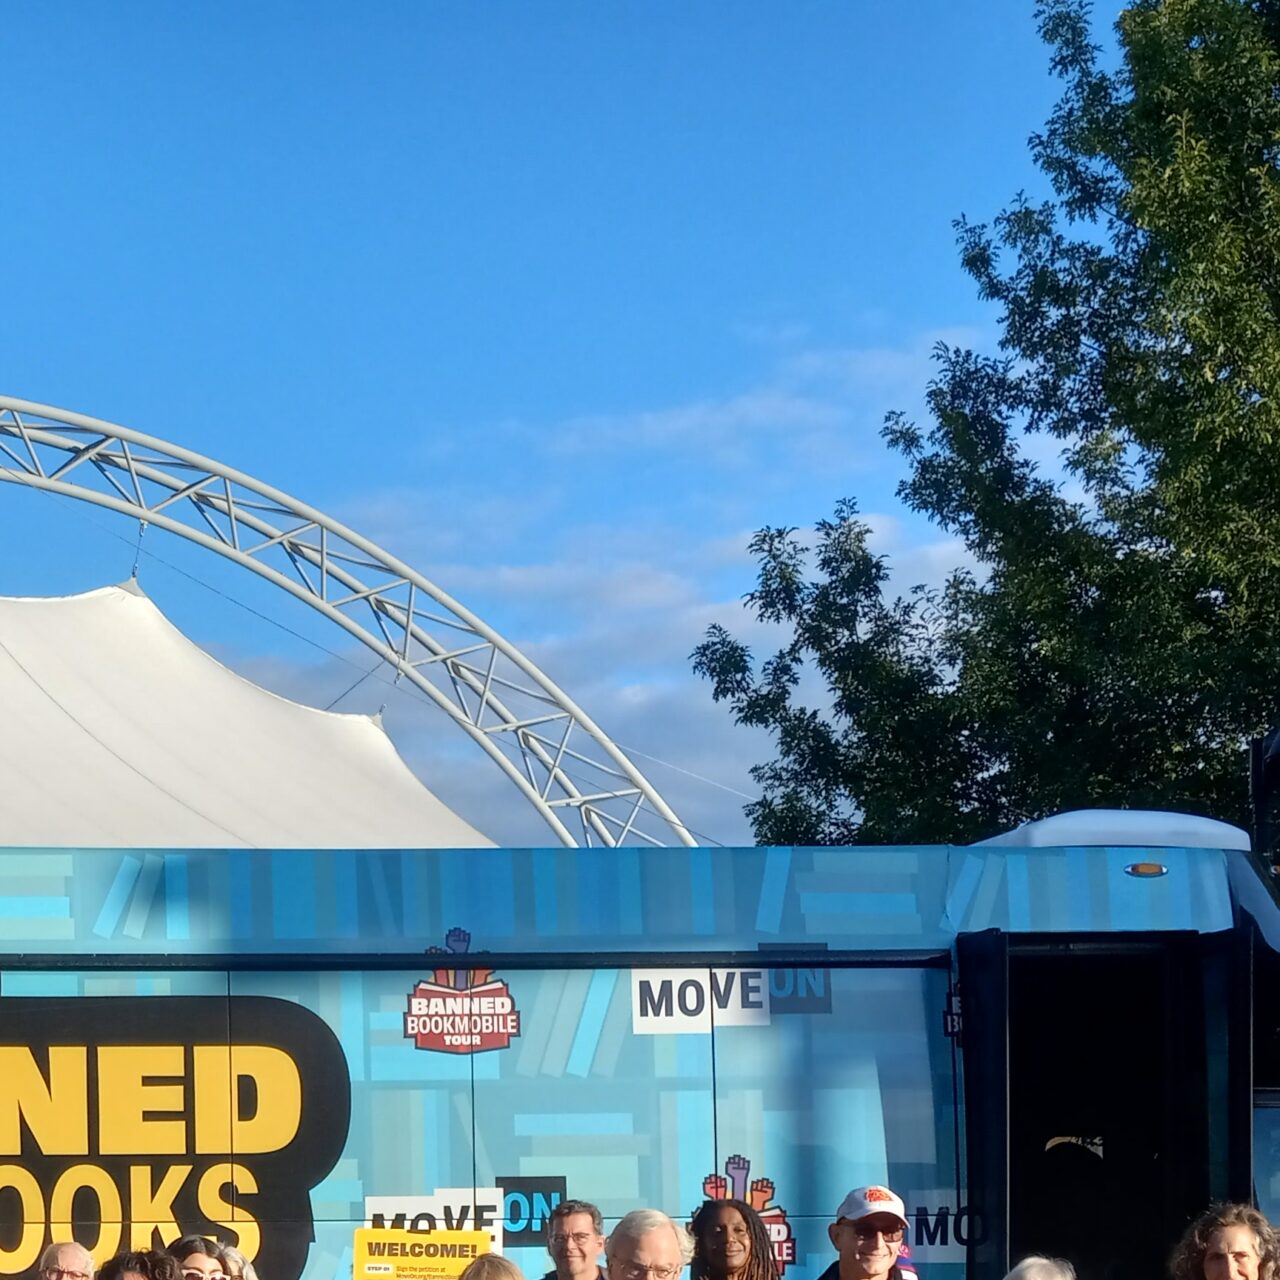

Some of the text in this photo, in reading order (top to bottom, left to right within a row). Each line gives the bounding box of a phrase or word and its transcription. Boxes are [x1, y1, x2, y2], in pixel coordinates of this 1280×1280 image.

[639, 967, 825, 1018] MOVE ON
[411, 996, 512, 1015] BANNED
[407, 1015, 517, 1034] BOOKMOBILE
[444, 1035, 481, 1046] TOUR
[503, 1192, 561, 1232] ON
[367, 1242, 477, 1259] WELCOME!
